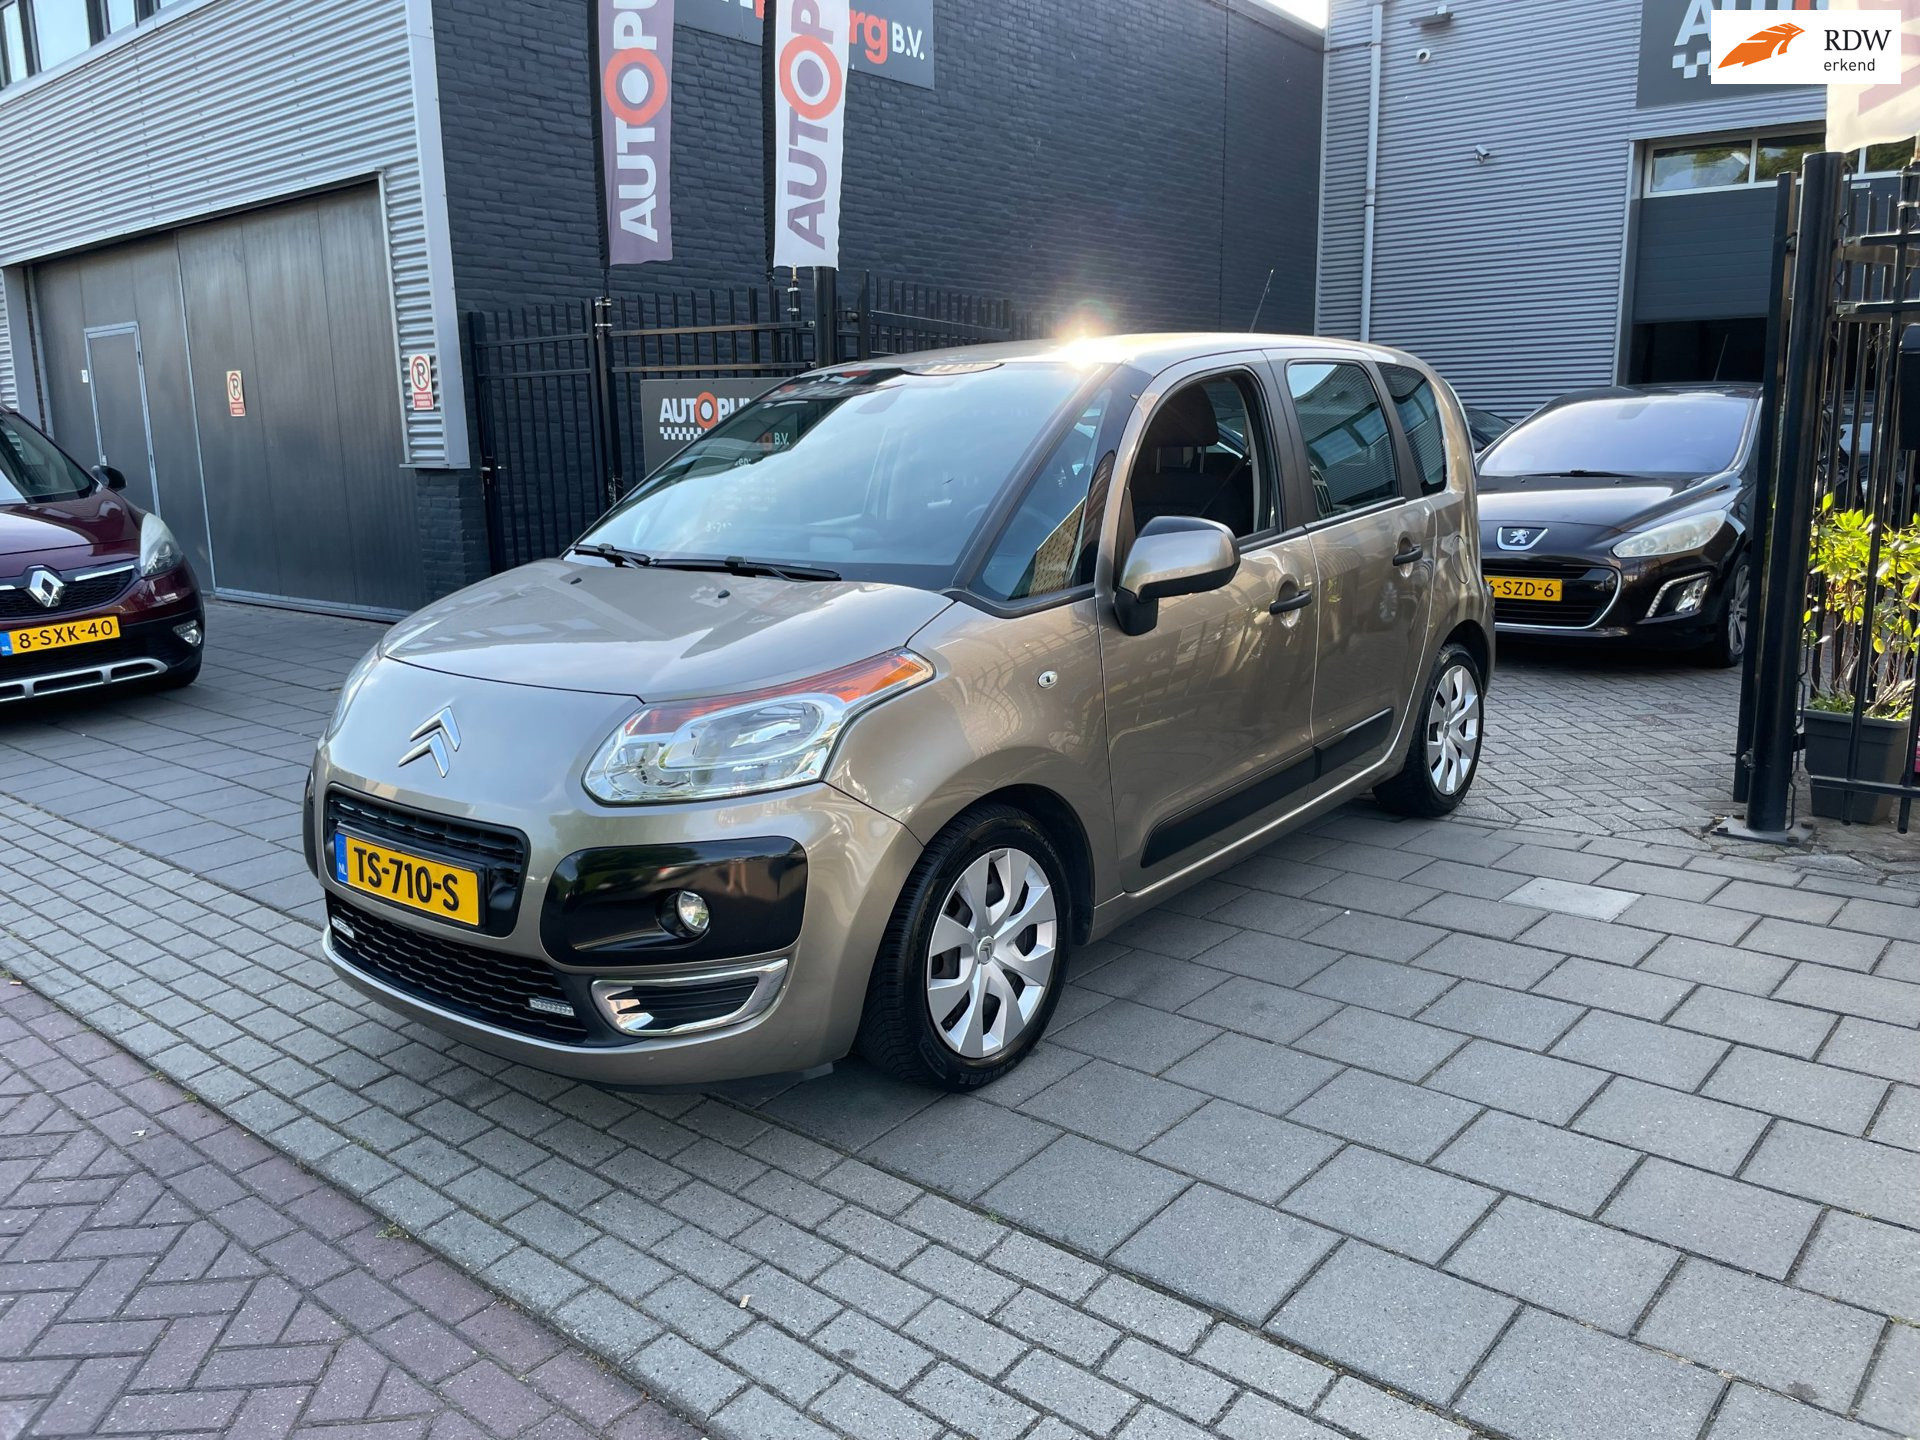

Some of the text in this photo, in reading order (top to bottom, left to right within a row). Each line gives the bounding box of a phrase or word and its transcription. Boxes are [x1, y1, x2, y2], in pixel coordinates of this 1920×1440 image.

[891, 21, 925, 61] B.V.
[19, 620, 113, 649] 8-SXK-40
[353, 846, 460, 911] TS-710-S
